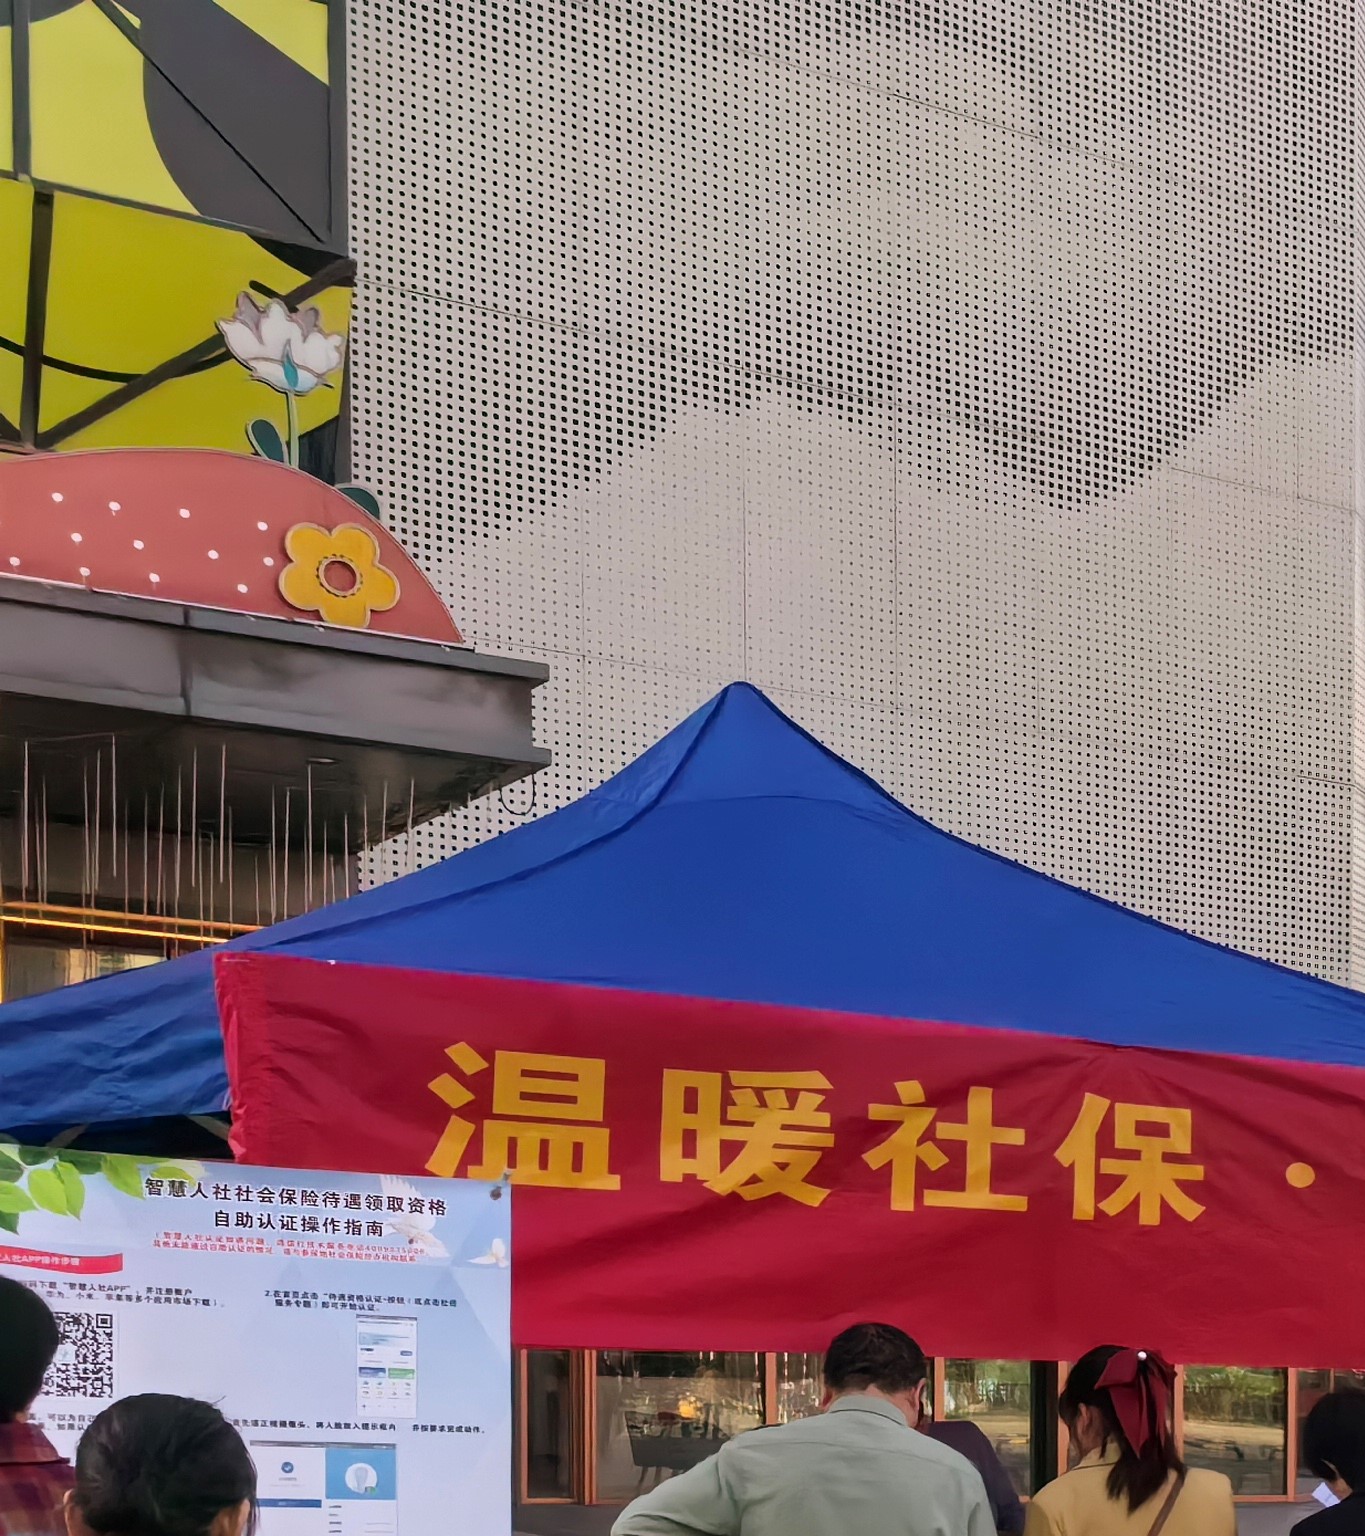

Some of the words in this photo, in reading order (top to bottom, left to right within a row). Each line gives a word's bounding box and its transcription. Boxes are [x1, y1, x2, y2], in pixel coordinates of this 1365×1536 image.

[144, 1177, 448, 1216] 智慧人社社会保险待遇领取资格
[214, 1209, 385, 1237] 自助认证操作指南
